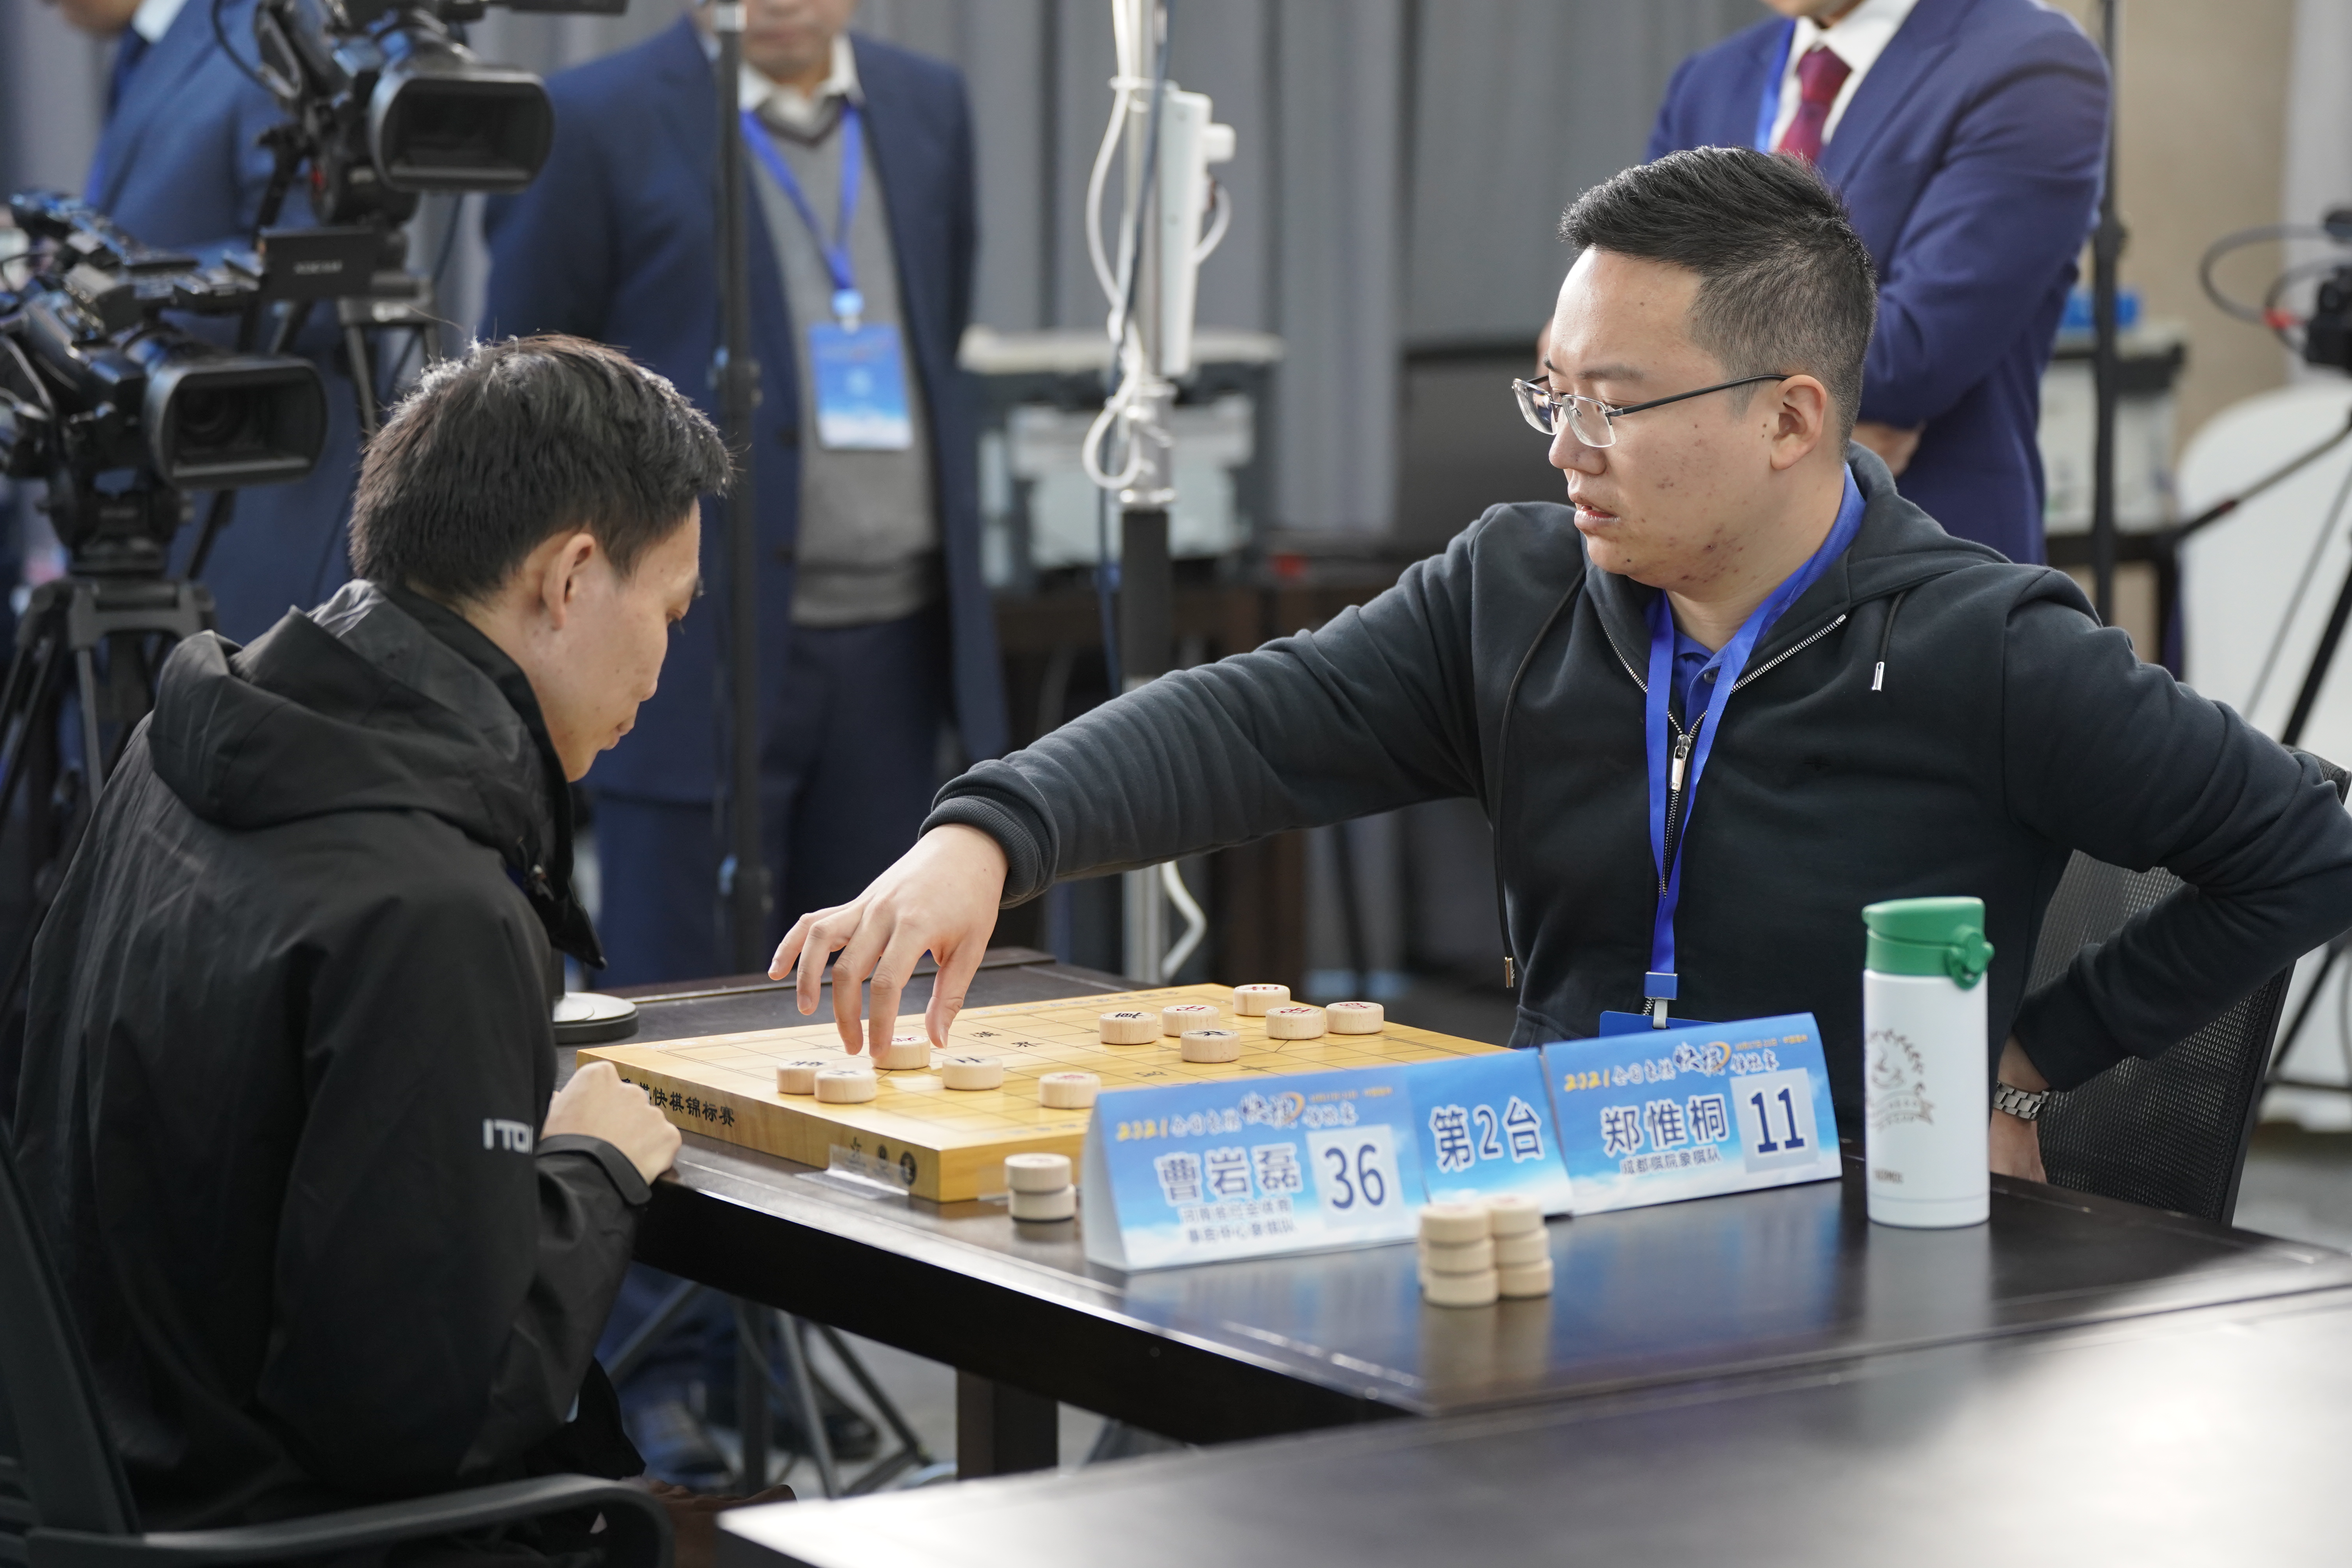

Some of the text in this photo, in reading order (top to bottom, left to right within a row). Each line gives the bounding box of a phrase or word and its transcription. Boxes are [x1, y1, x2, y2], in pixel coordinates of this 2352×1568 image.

[621, 1078, 735, 1127] 快棋锦标赛
[1603, 1096, 1726, 1152] 郑惟桐
[1750, 1087, 1805, 1154] 11
[1432, 1100, 1541, 1168] 第2台
[1159, 1145, 1299, 1201] 曹岩磊
[1325, 1143, 1386, 1210] 36
